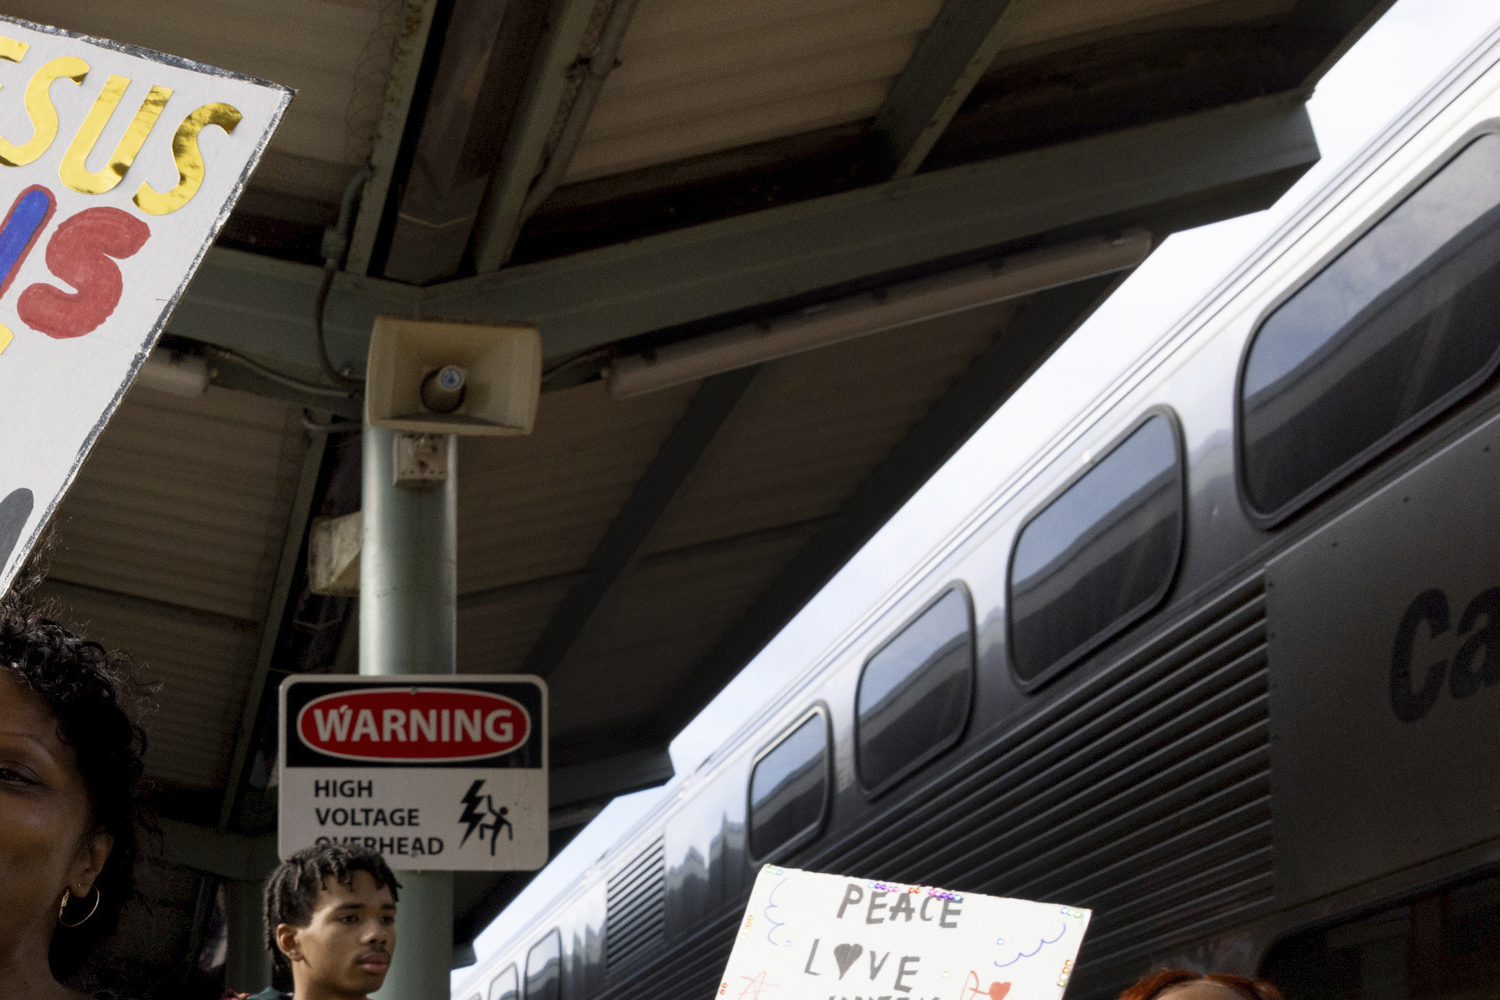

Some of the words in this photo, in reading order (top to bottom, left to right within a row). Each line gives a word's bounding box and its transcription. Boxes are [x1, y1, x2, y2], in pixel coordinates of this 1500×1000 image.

[313, 708, 515, 743] WARNING
[314, 780, 373, 798] HIGH
[315, 808, 420, 827] VOLTAGE
[836, 883, 964, 929] PEACE
[804, 938, 921, 993] LVE
